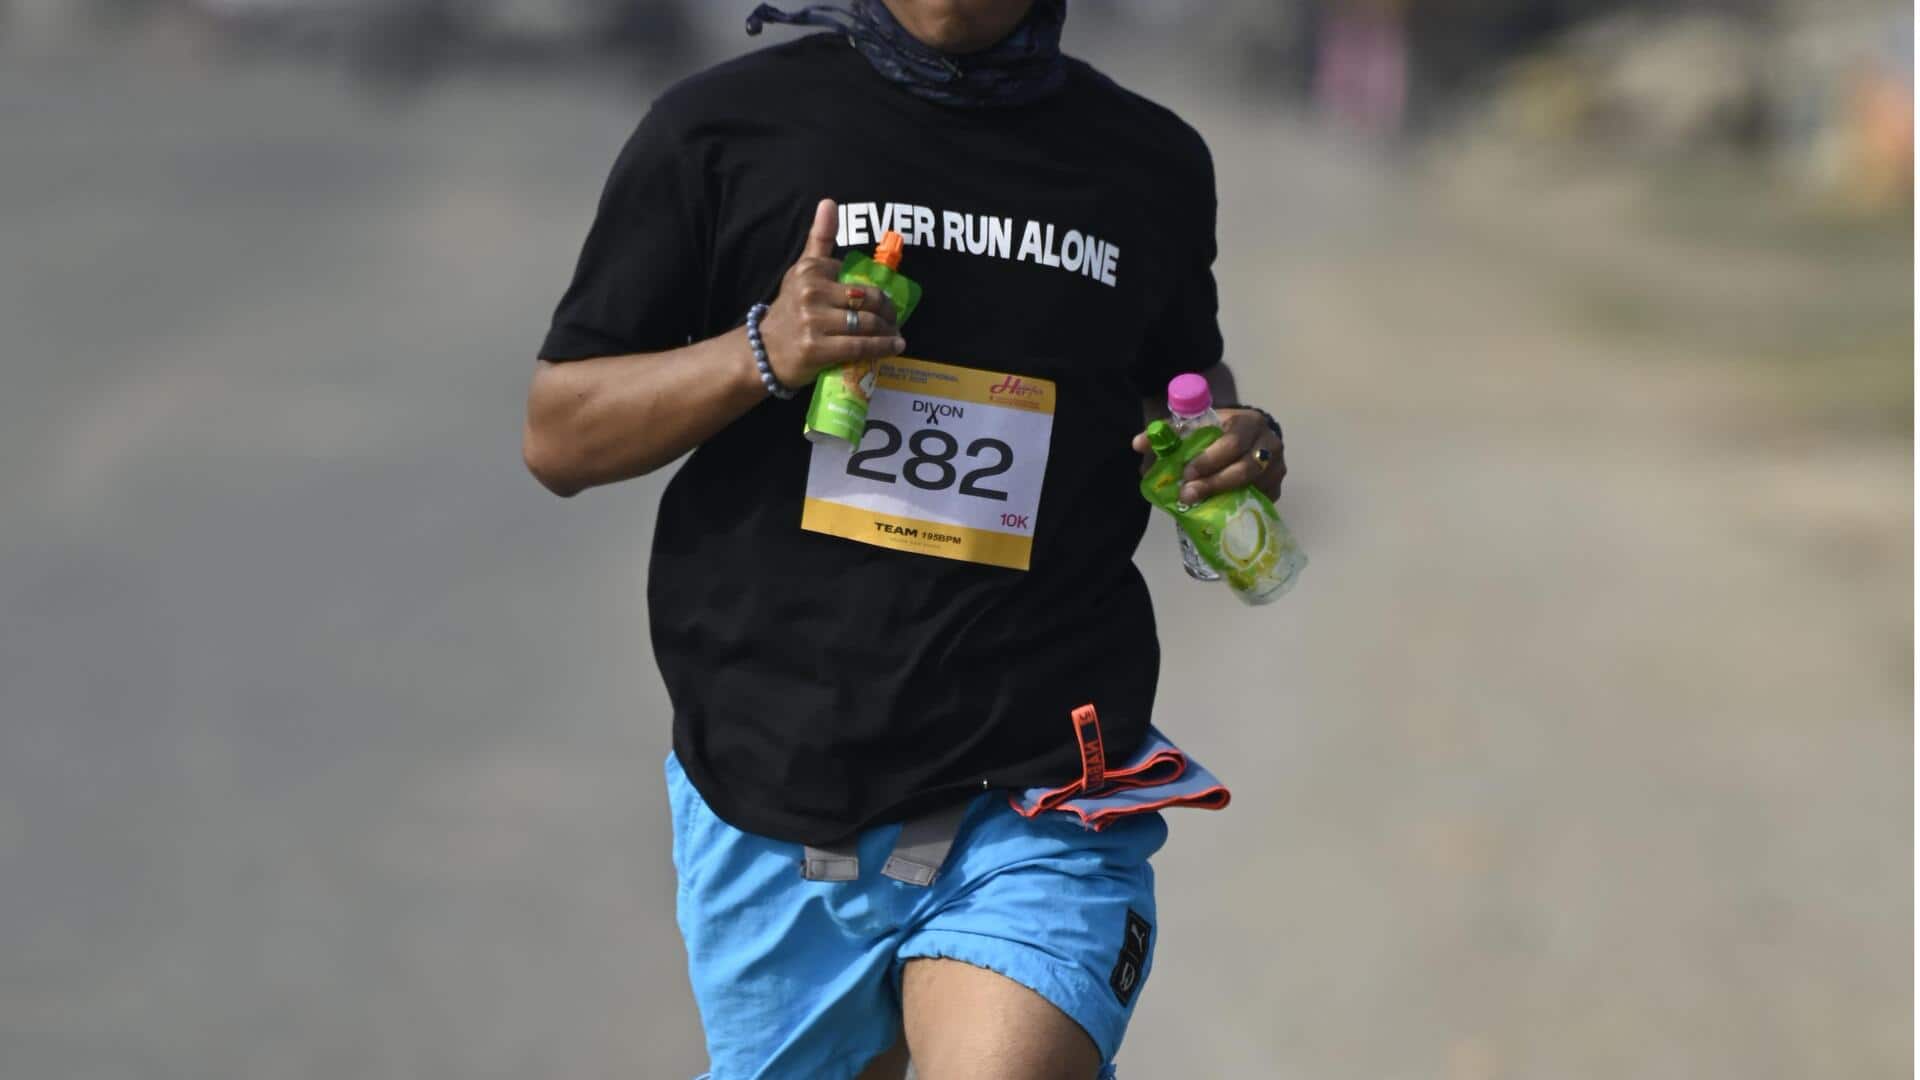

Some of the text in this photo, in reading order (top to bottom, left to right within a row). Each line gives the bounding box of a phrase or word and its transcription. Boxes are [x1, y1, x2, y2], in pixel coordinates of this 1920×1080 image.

[943, 211, 1012, 258] RUN
[1017, 221, 1120, 287] ALONE
[846, 419, 1014, 501] 282
[874, 522, 918, 538] TEAM
[1000, 513, 1029, 529] 10K
